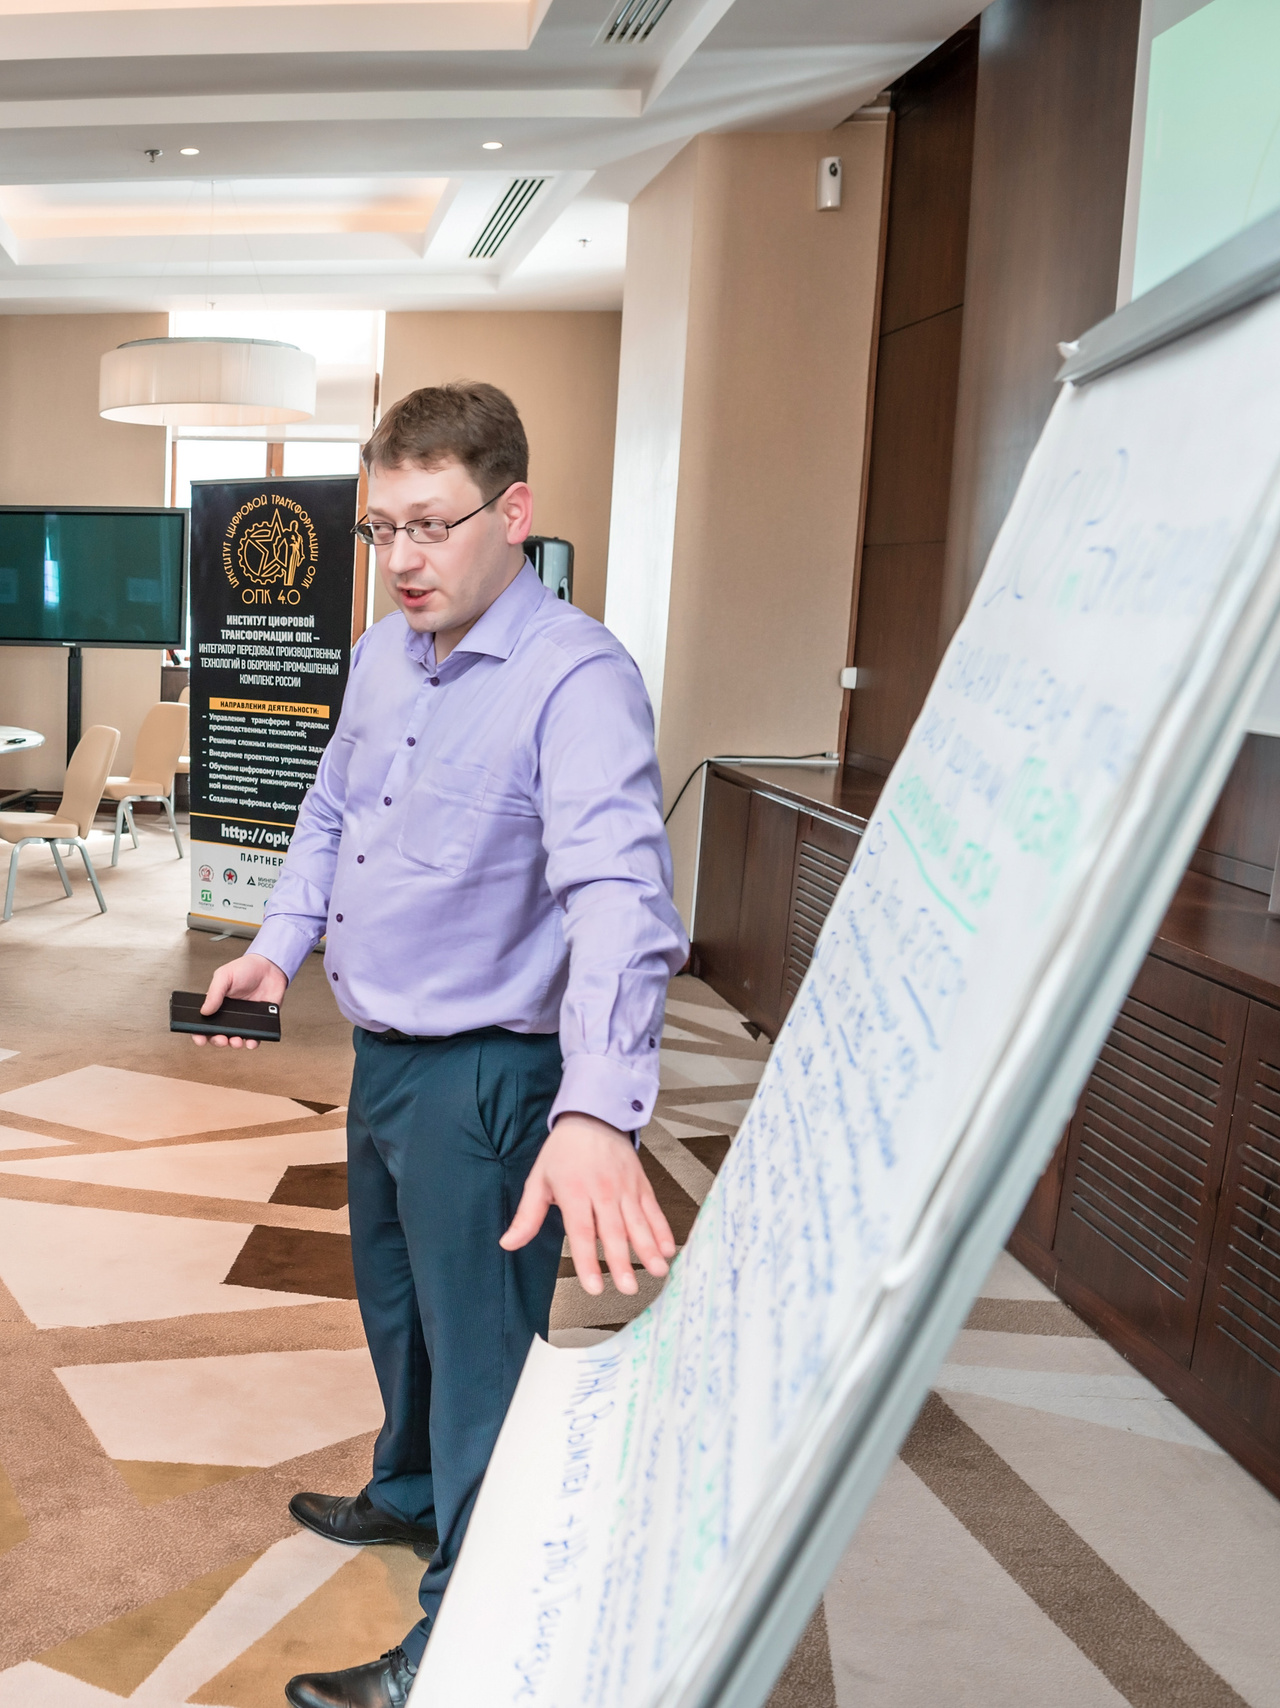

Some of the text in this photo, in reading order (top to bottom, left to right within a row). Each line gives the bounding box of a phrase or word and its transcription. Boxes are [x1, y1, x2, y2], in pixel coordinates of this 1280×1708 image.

[241, 588, 272, 604] ОПК
[226, 615, 315, 628] ИНСТИТУТ ЦИФРОВОЙ
[220, 629, 294, 643] ТРАНСФОРМАЦИИ
[295, 632, 313, 643] ОПК
[198, 643, 342, 660] ИНТЕГРАТОР ПЕРЕДОВЫХ ПРОИЗВОДСТВЕННЫХ
[200, 657, 339, 675] ТЕХНОЛОГИЙ В ОБОРОННО-ПРОМЫШЛЕННЫЙ
[239, 673, 301, 688] КОМПЛЕКС РОССИИ
[220, 701, 320, 715] НАПРАВЛЕНИЯ ДЕЯТЕЛЬНОСТИ:
[209, 713, 330, 730] Управление трансфером передовых
[209, 724, 268, 735] производственных
[209, 736, 237, 745] Решение
[237, 739, 266, 748] сложных
[266, 742, 307, 752] инженерных
[209, 749, 243, 759] Внедрение
[244, 752, 279, 762] проектного
[209, 762, 317, 780] Обучение цифровому проектирова
[209, 772, 259, 785] компьютерному
[209, 794, 238, 804] Создание
[239, 798, 271, 809] цифровых
[272, 801, 297, 811] фабрик
[240, 852, 284, 867] ПАРТНЕР
